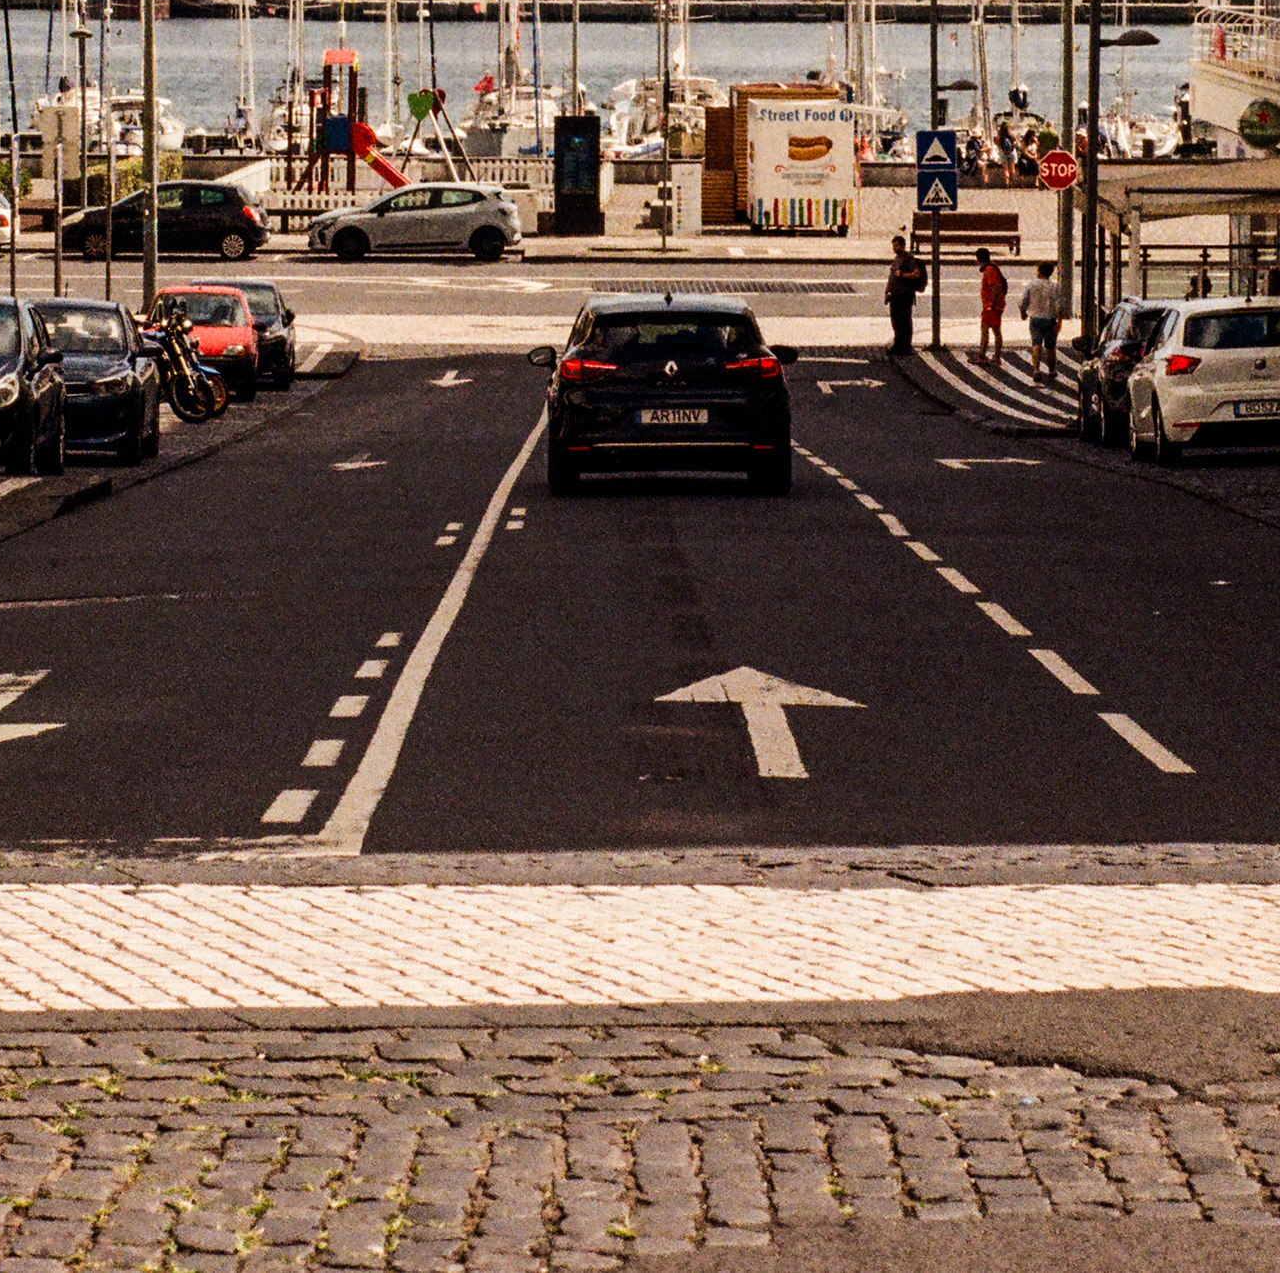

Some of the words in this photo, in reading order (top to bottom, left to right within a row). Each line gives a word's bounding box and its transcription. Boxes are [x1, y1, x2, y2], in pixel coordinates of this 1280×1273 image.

[760, 108, 800, 121] Street
[804, 109, 836, 121] Food
[1040, 162, 1076, 177] STOP
